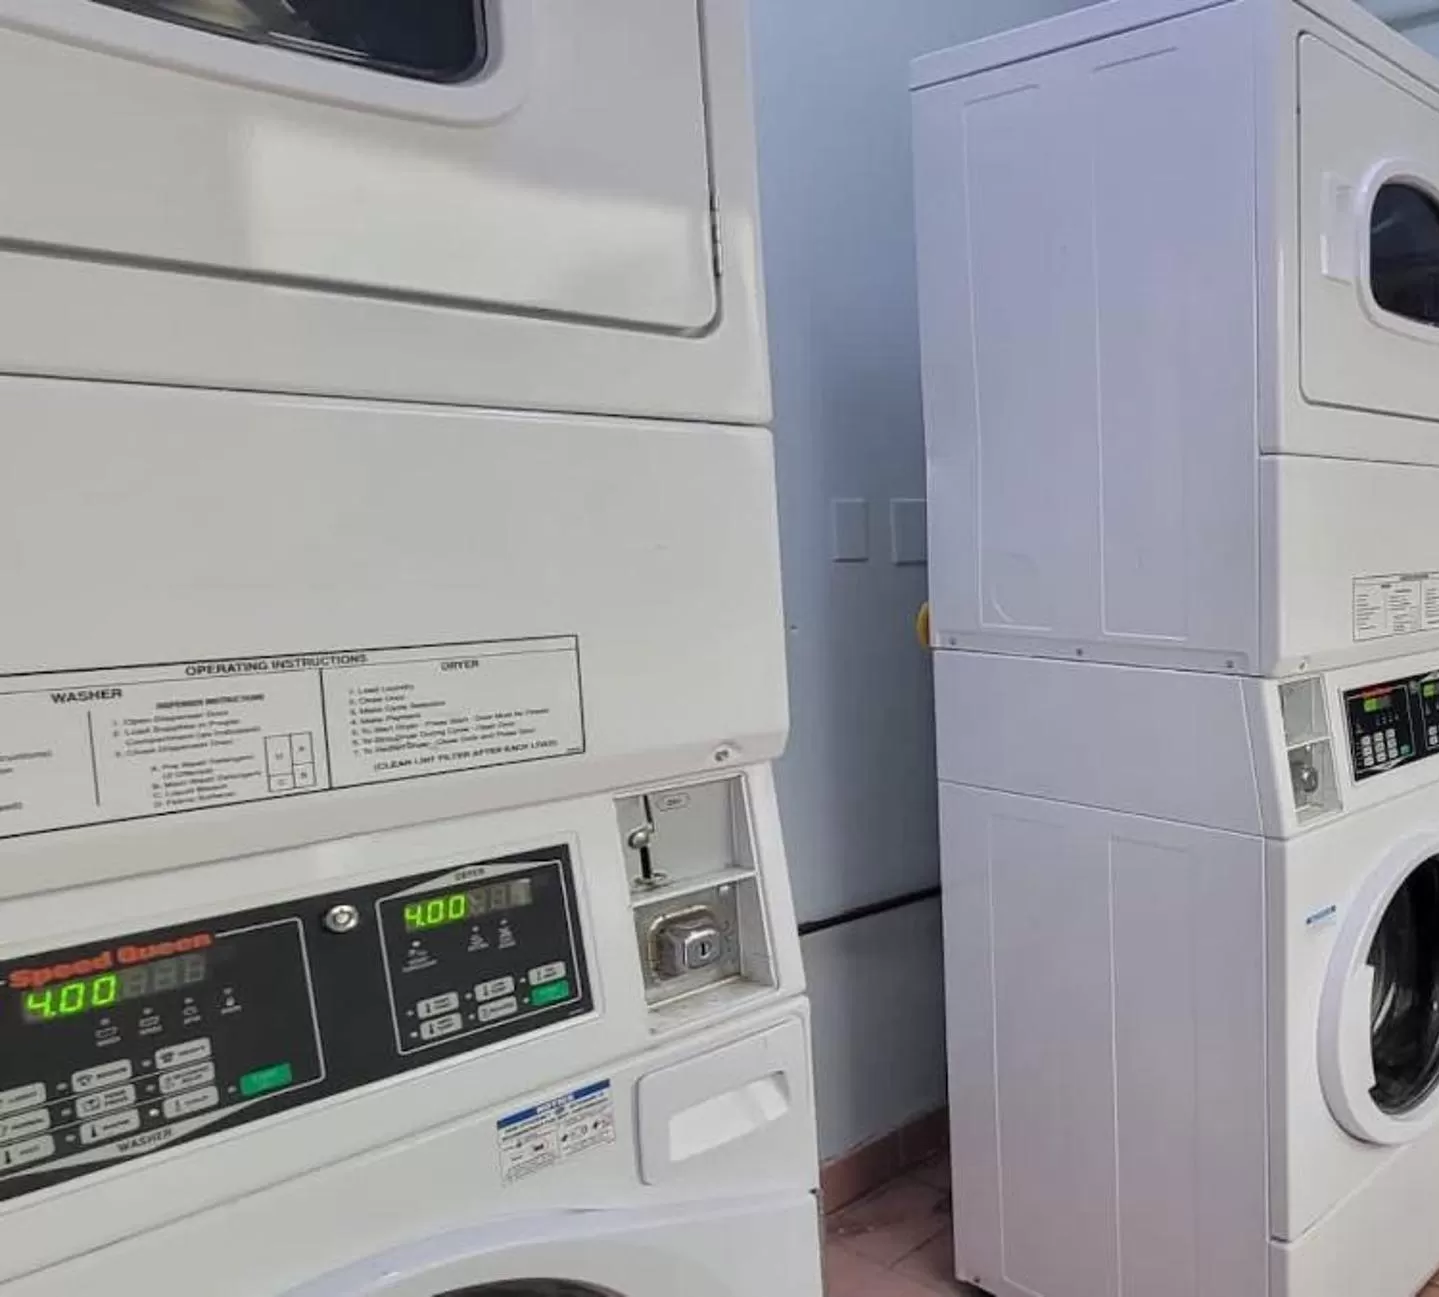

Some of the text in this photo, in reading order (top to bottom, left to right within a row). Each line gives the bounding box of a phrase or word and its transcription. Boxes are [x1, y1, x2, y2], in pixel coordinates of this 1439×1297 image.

[185, 654, 368, 676] OPERATING INSTRUCTIONS
[441, 659, 479, 671] DRYER
[50, 688, 123, 704] WASHER
[404, 894, 466, 928] 4.00
[9, 933, 214, 990] Speed Queen
[25, 973, 118, 1017] 4.00
[116, 1127, 173, 1153] WASHER
